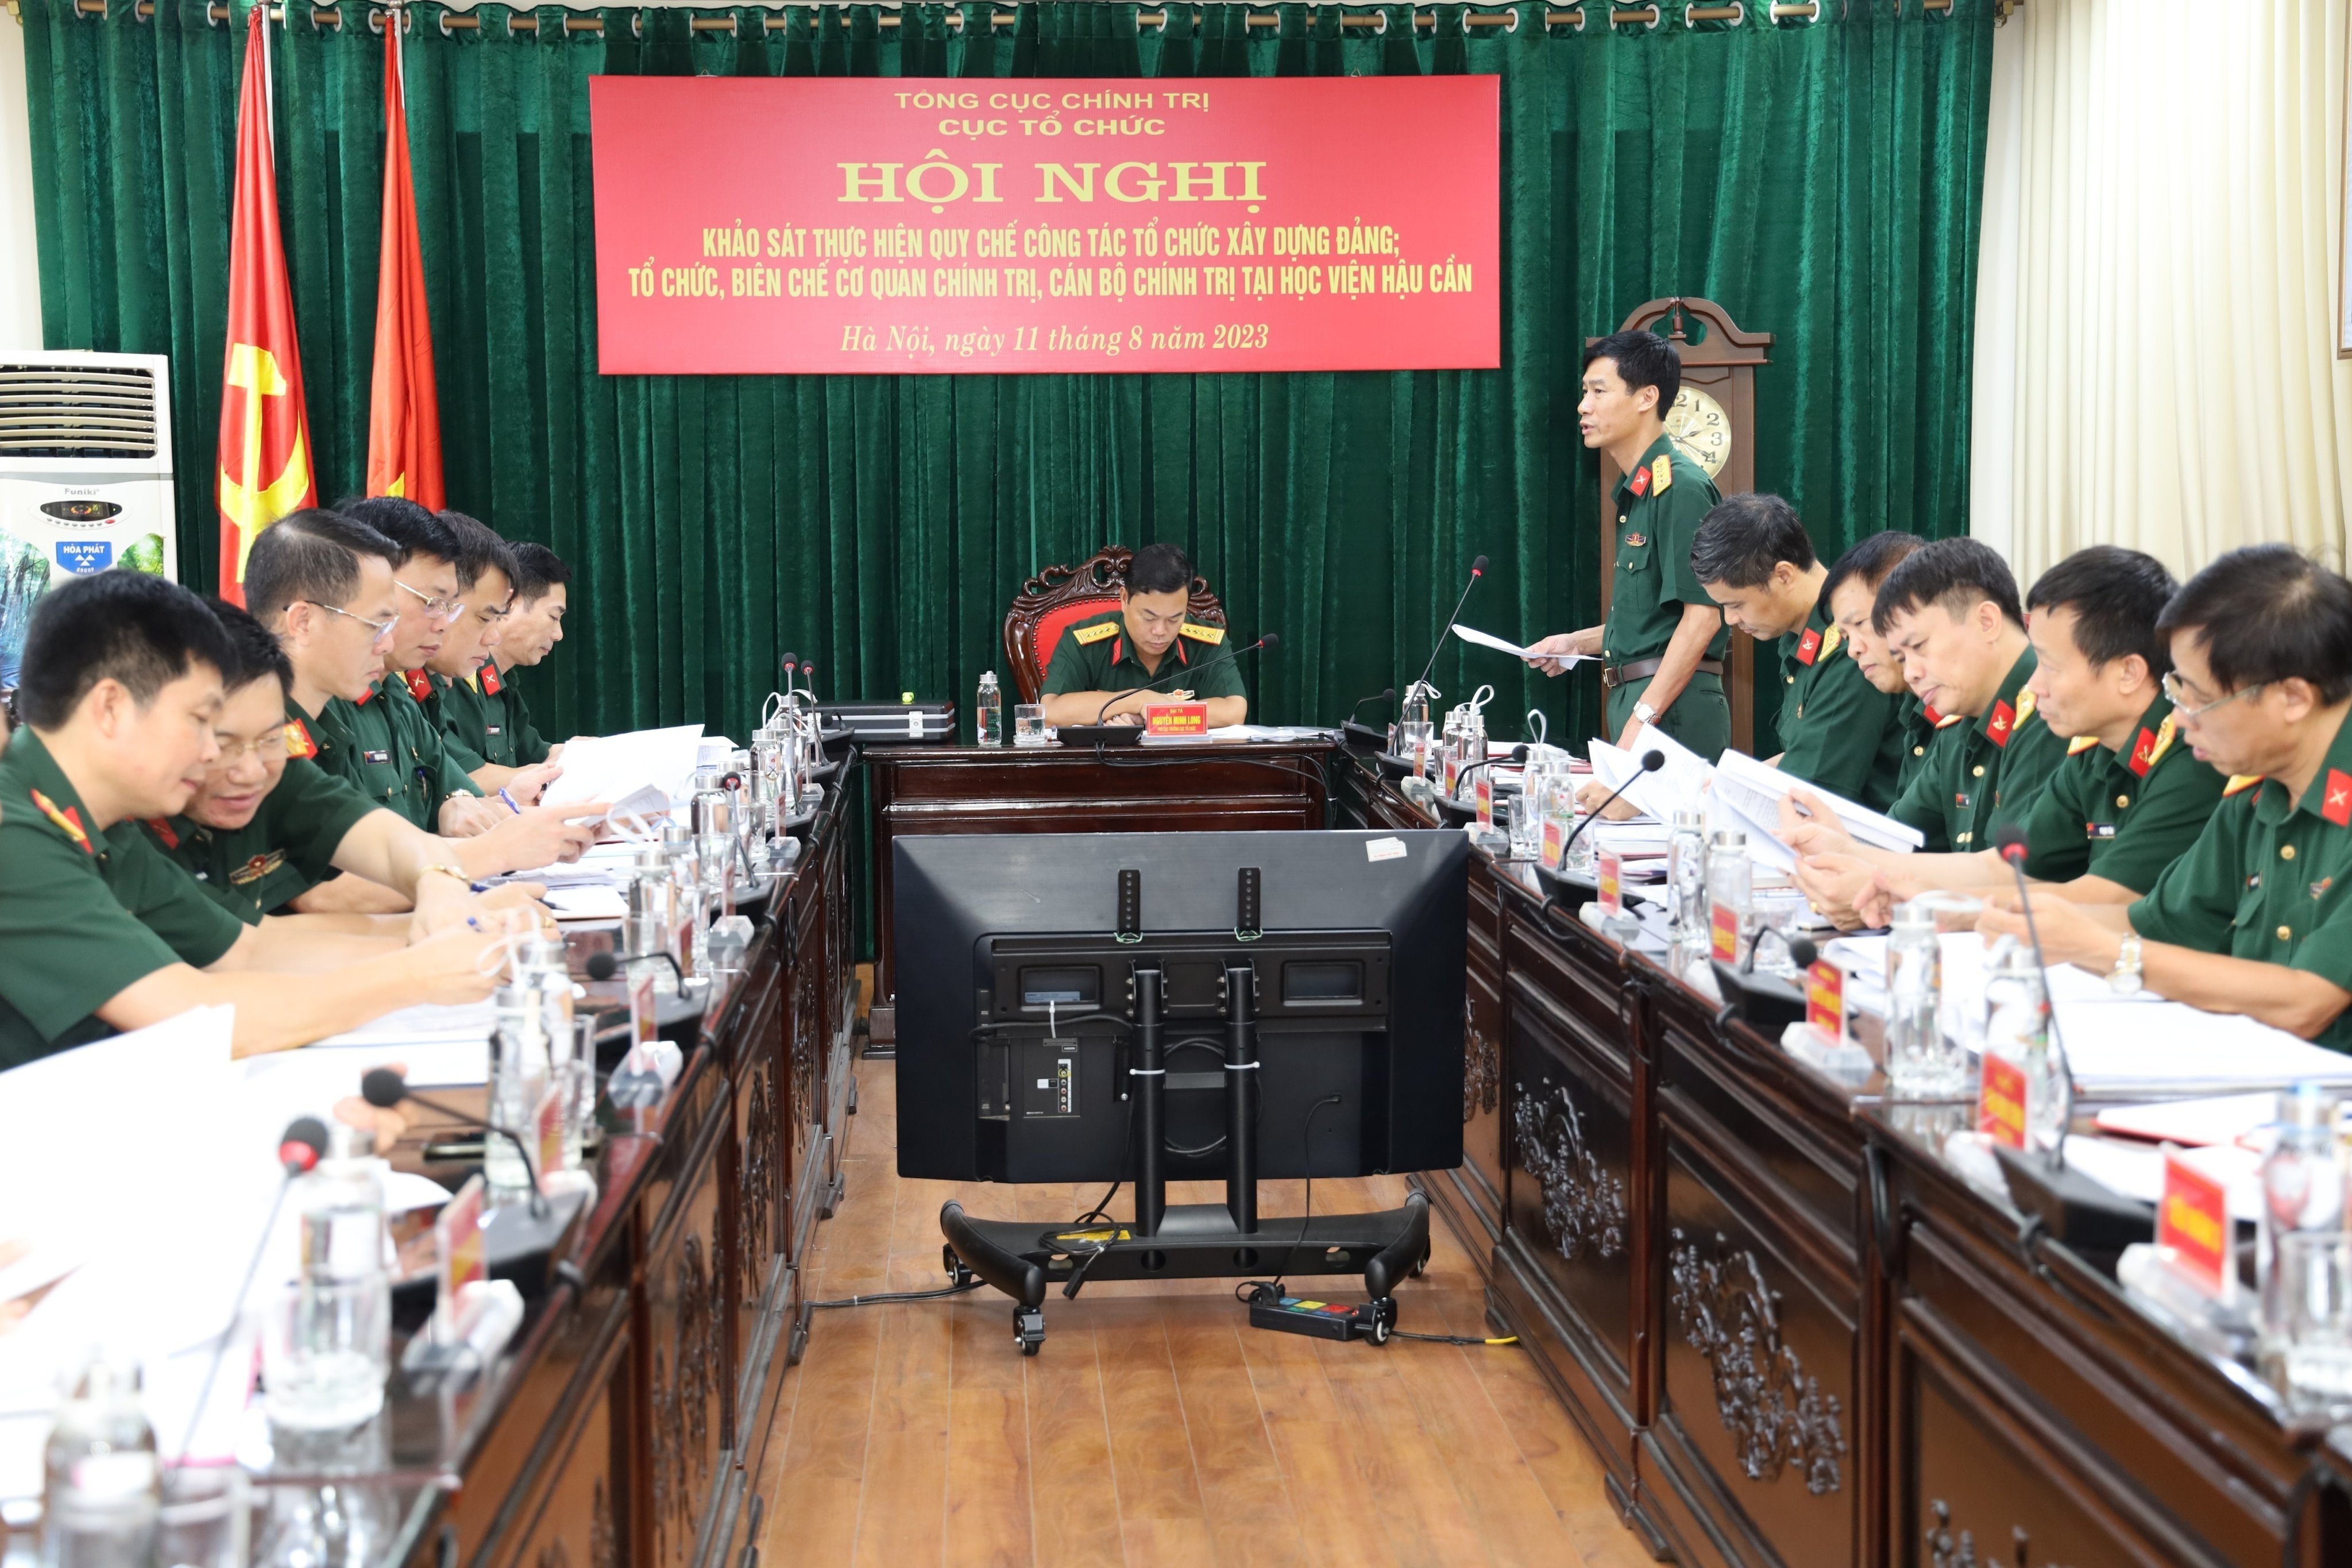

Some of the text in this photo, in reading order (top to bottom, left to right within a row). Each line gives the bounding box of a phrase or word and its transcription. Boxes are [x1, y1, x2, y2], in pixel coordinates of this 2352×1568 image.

[989, 93, 1051, 113] CỤC
[1061, 89, 1153, 109] CHÍNH
[1163, 92, 1209, 113] TRỊ
[939, 109, 1165, 141] CỤC TỔ CHỨC
[836, 148, 1267, 214] HỘI NGHỊ
[702, 215, 1400, 264] KHẢO SÁT THỰC HIỆN QUY CHẾ CÔNG TÁC TỔ CHỨC XÂY DỰNG ĐẢNG;
[628, 253, 1472, 303] TỔ CHỨC, BIÊN CHẾ CƠ QUAN CHÍNH TRỊ, CÁN BỘ CHÍNH TRỊ TẠI HỌC VIỆN HẬU CẦN
[840, 323, 1269, 359] Hà Nội, ngày 11 tháng 8 năm 2023
[1694, 399, 1700, 412] 1
[1706, 413, 1720, 426] 2
[1710, 432, 1723, 446] 3
[63, 543, 105, 554] HÒA PHÁT
[1173, 716, 1187, 725] MINH
[1187, 715, 1201, 725] LONG
